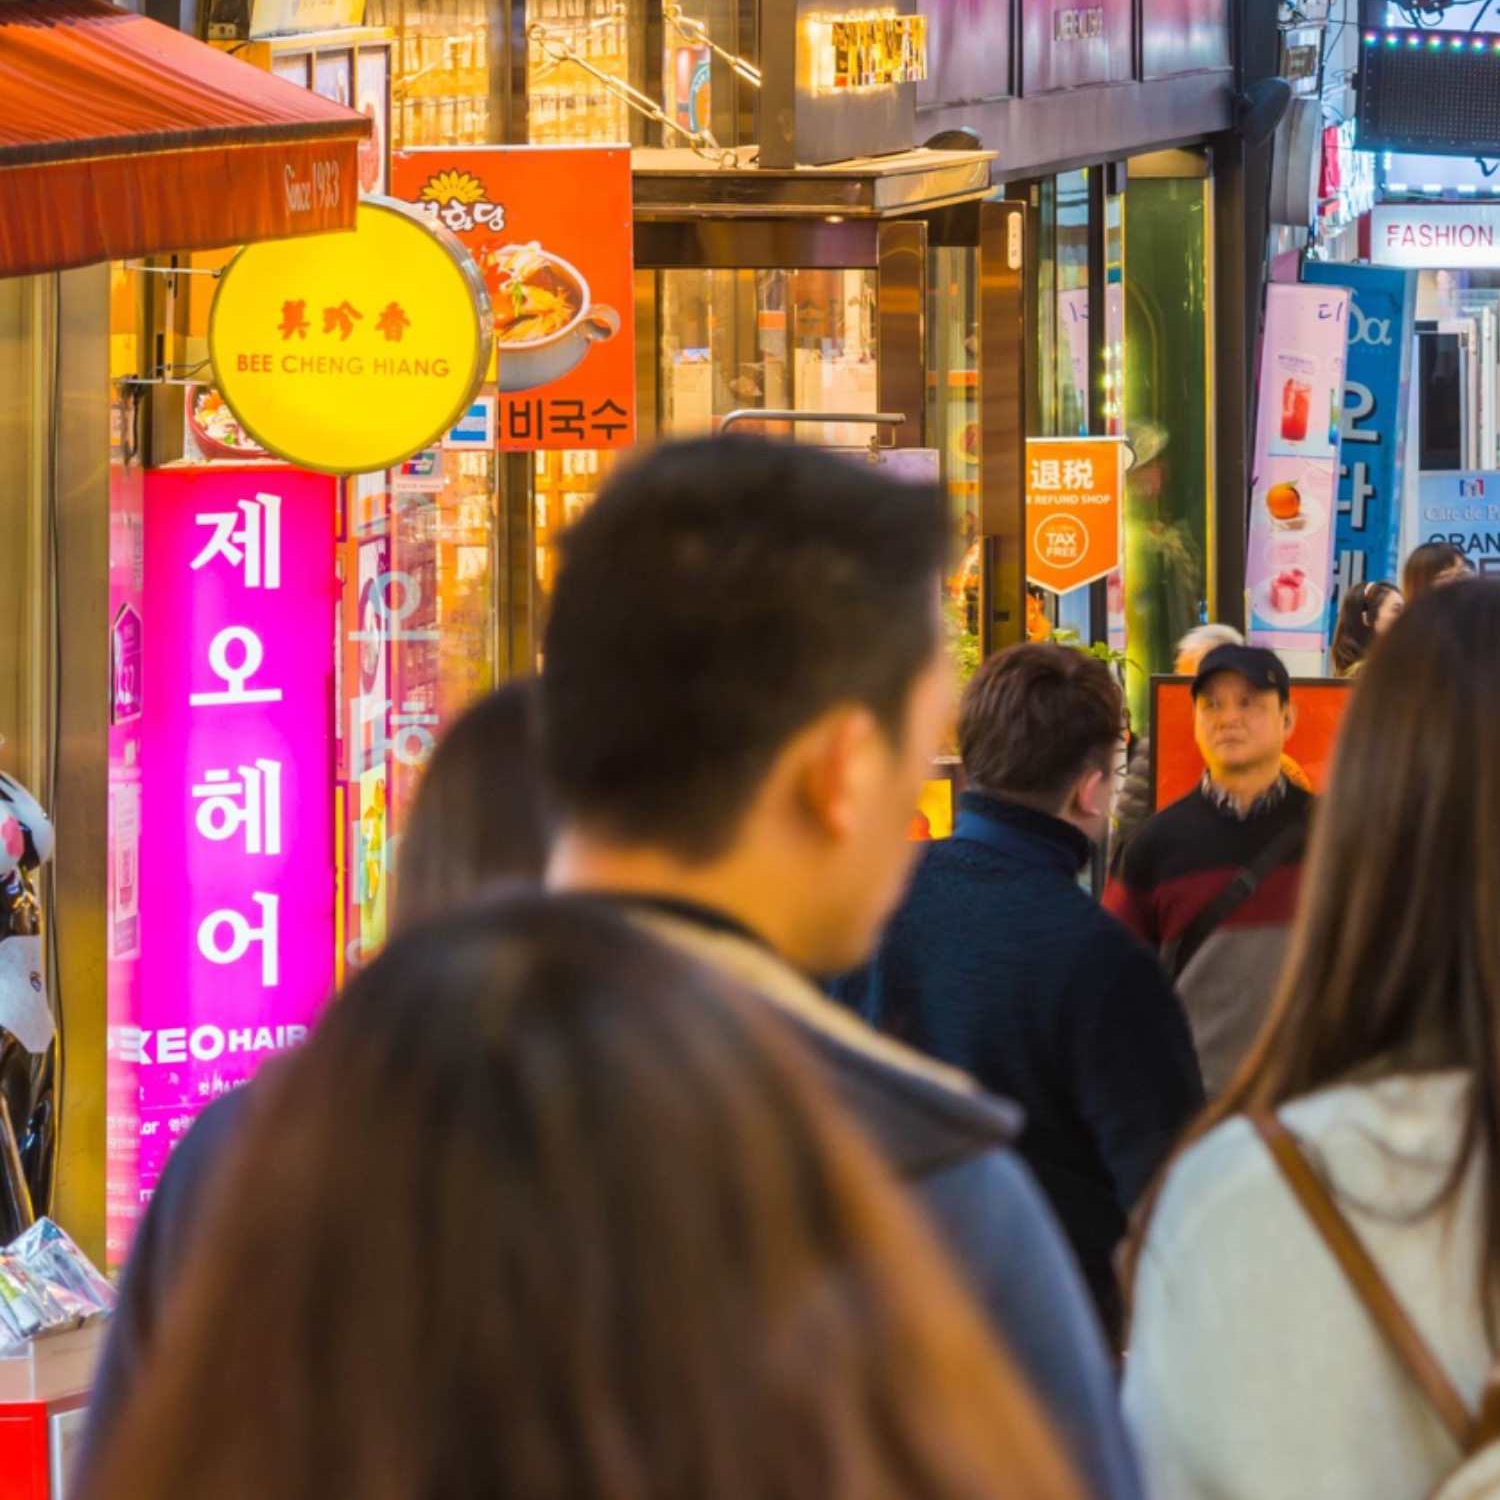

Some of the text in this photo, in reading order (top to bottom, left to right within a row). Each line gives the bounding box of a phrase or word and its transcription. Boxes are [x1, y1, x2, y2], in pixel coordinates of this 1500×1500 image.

[1386, 223, 1493, 248] FASHION
[236, 353, 450, 377] BEE CHENG HIANG
[1034, 494, 1111, 505] REFUND SHOP
[1045, 532, 1077, 546] TAX
[1046, 546, 1077, 558] FREE
[189, 491, 283, 988] 제오헤어
